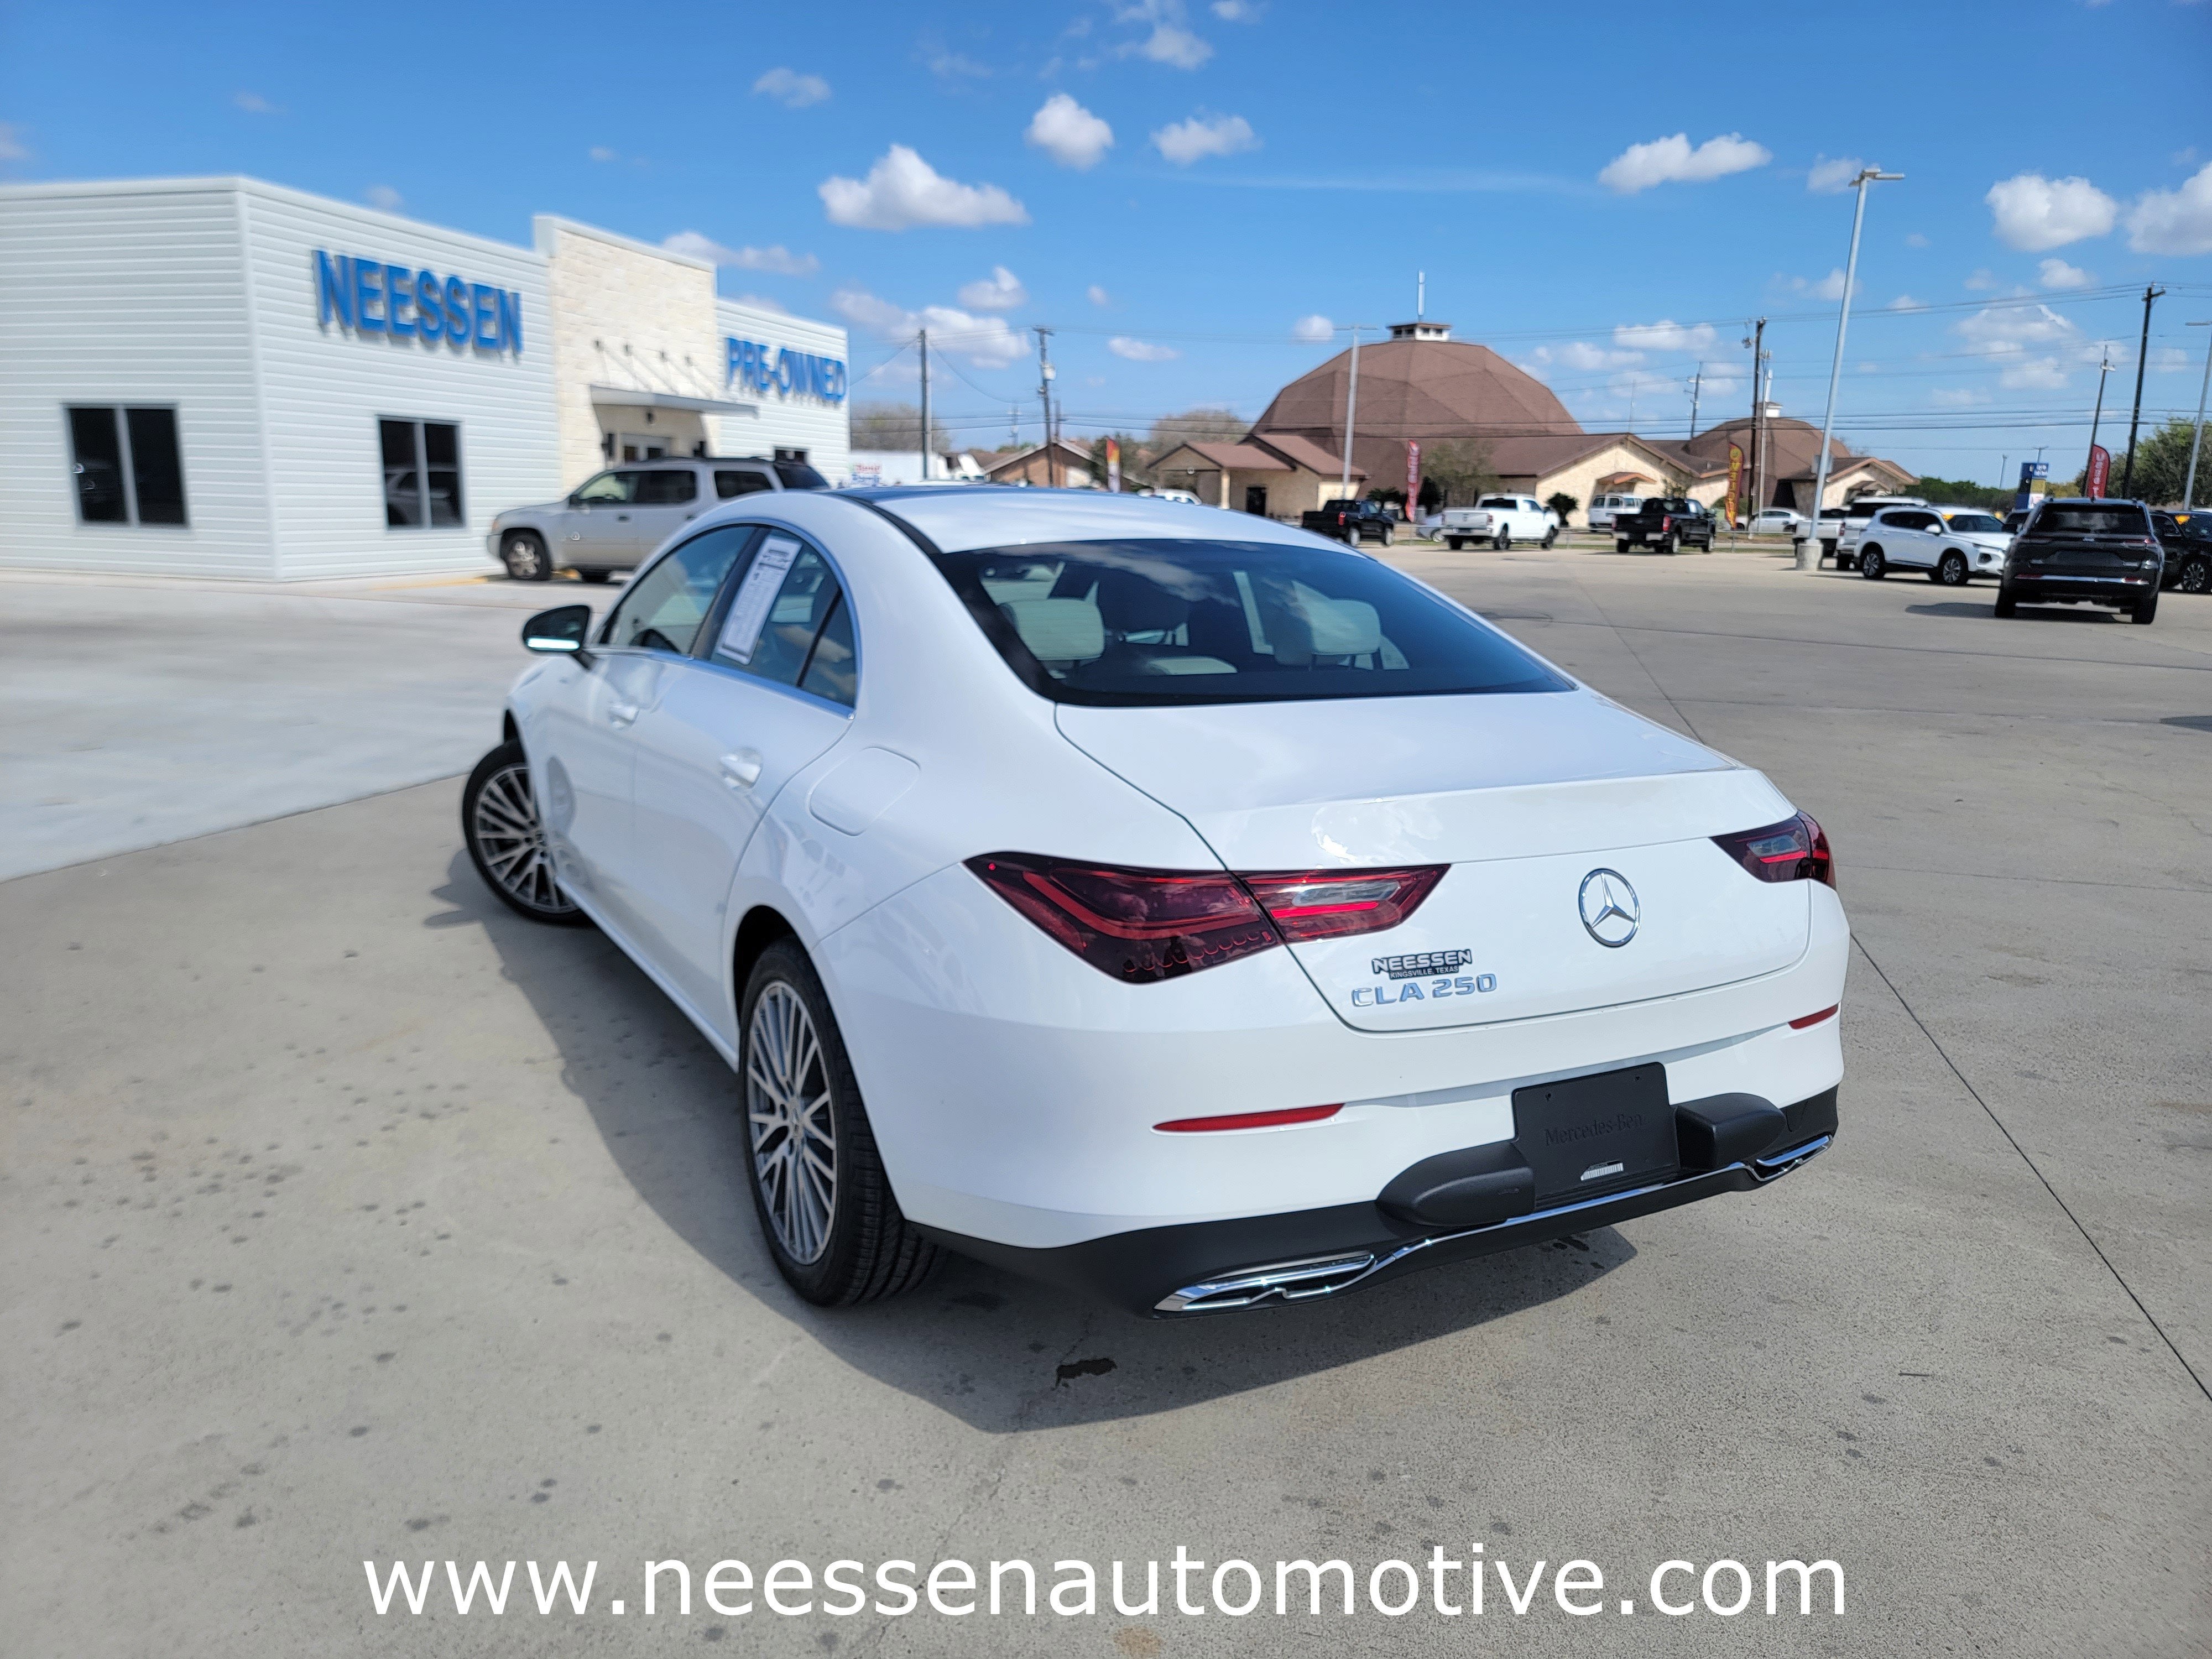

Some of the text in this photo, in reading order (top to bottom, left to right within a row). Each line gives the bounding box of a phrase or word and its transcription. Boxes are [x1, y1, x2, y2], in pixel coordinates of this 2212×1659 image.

[312, 249, 523, 355] NEESSEN
[724, 336, 847, 403] PRE-OWNED
[1372, 949, 1472, 973] NEESSEN
[1435, 965, 1459, 974] TEXAS
[1352, 973, 1497, 1008] CLA 250
